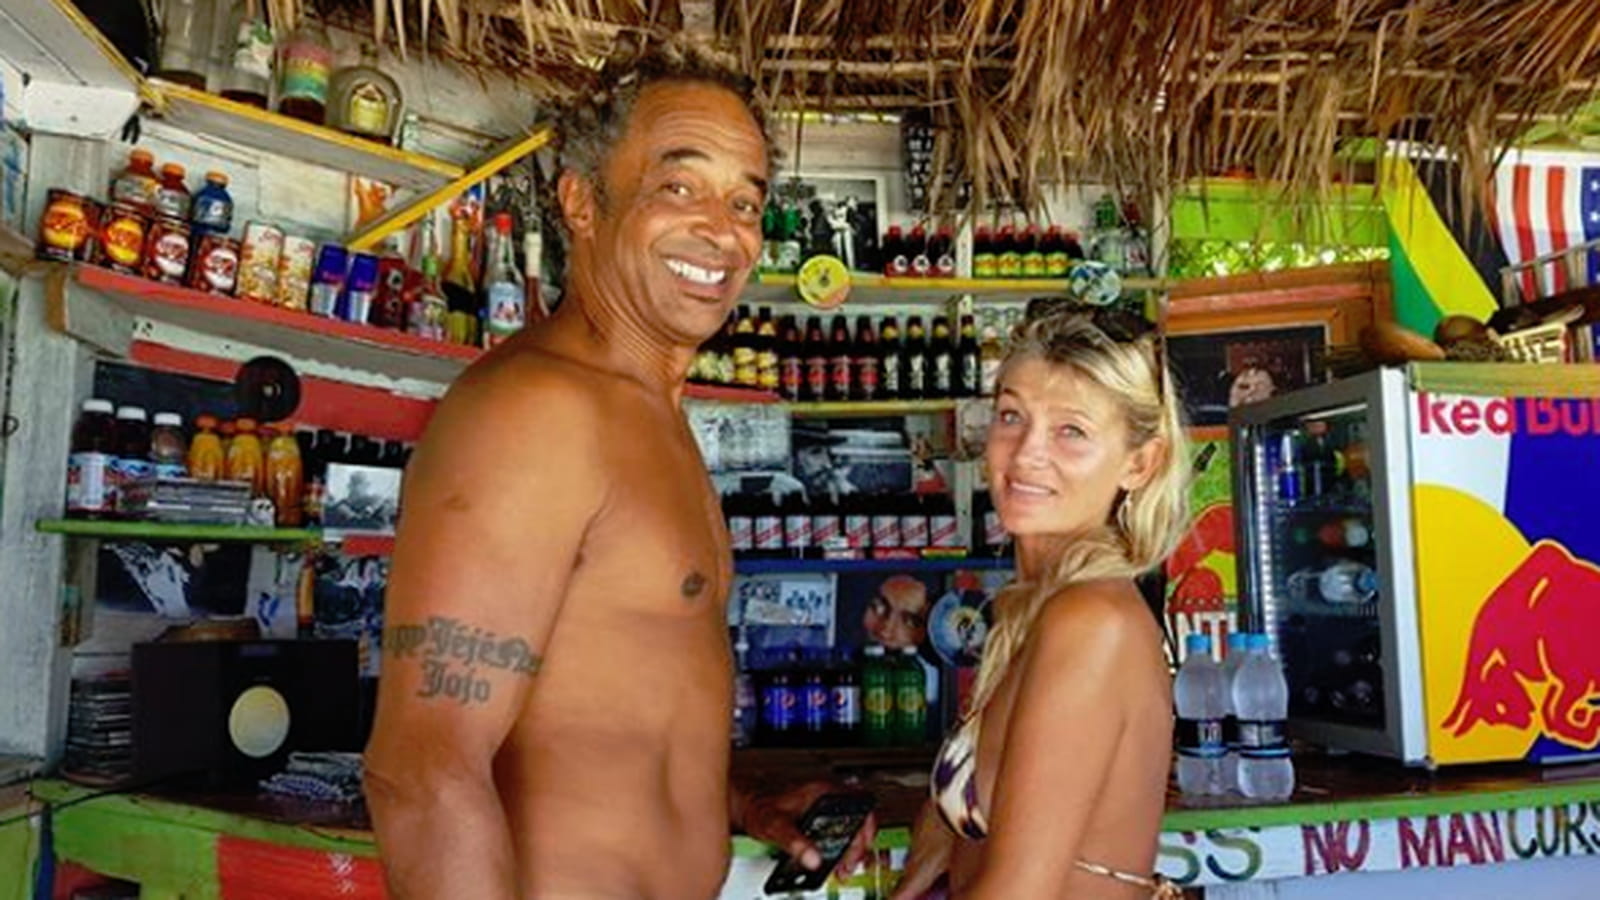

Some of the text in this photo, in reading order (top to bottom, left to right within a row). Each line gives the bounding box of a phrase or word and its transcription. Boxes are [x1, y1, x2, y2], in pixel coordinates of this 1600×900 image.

[415, 659, 491, 704] Jojo
[1301, 819, 1369, 876] NO
[1399, 812, 1505, 868] MAN
